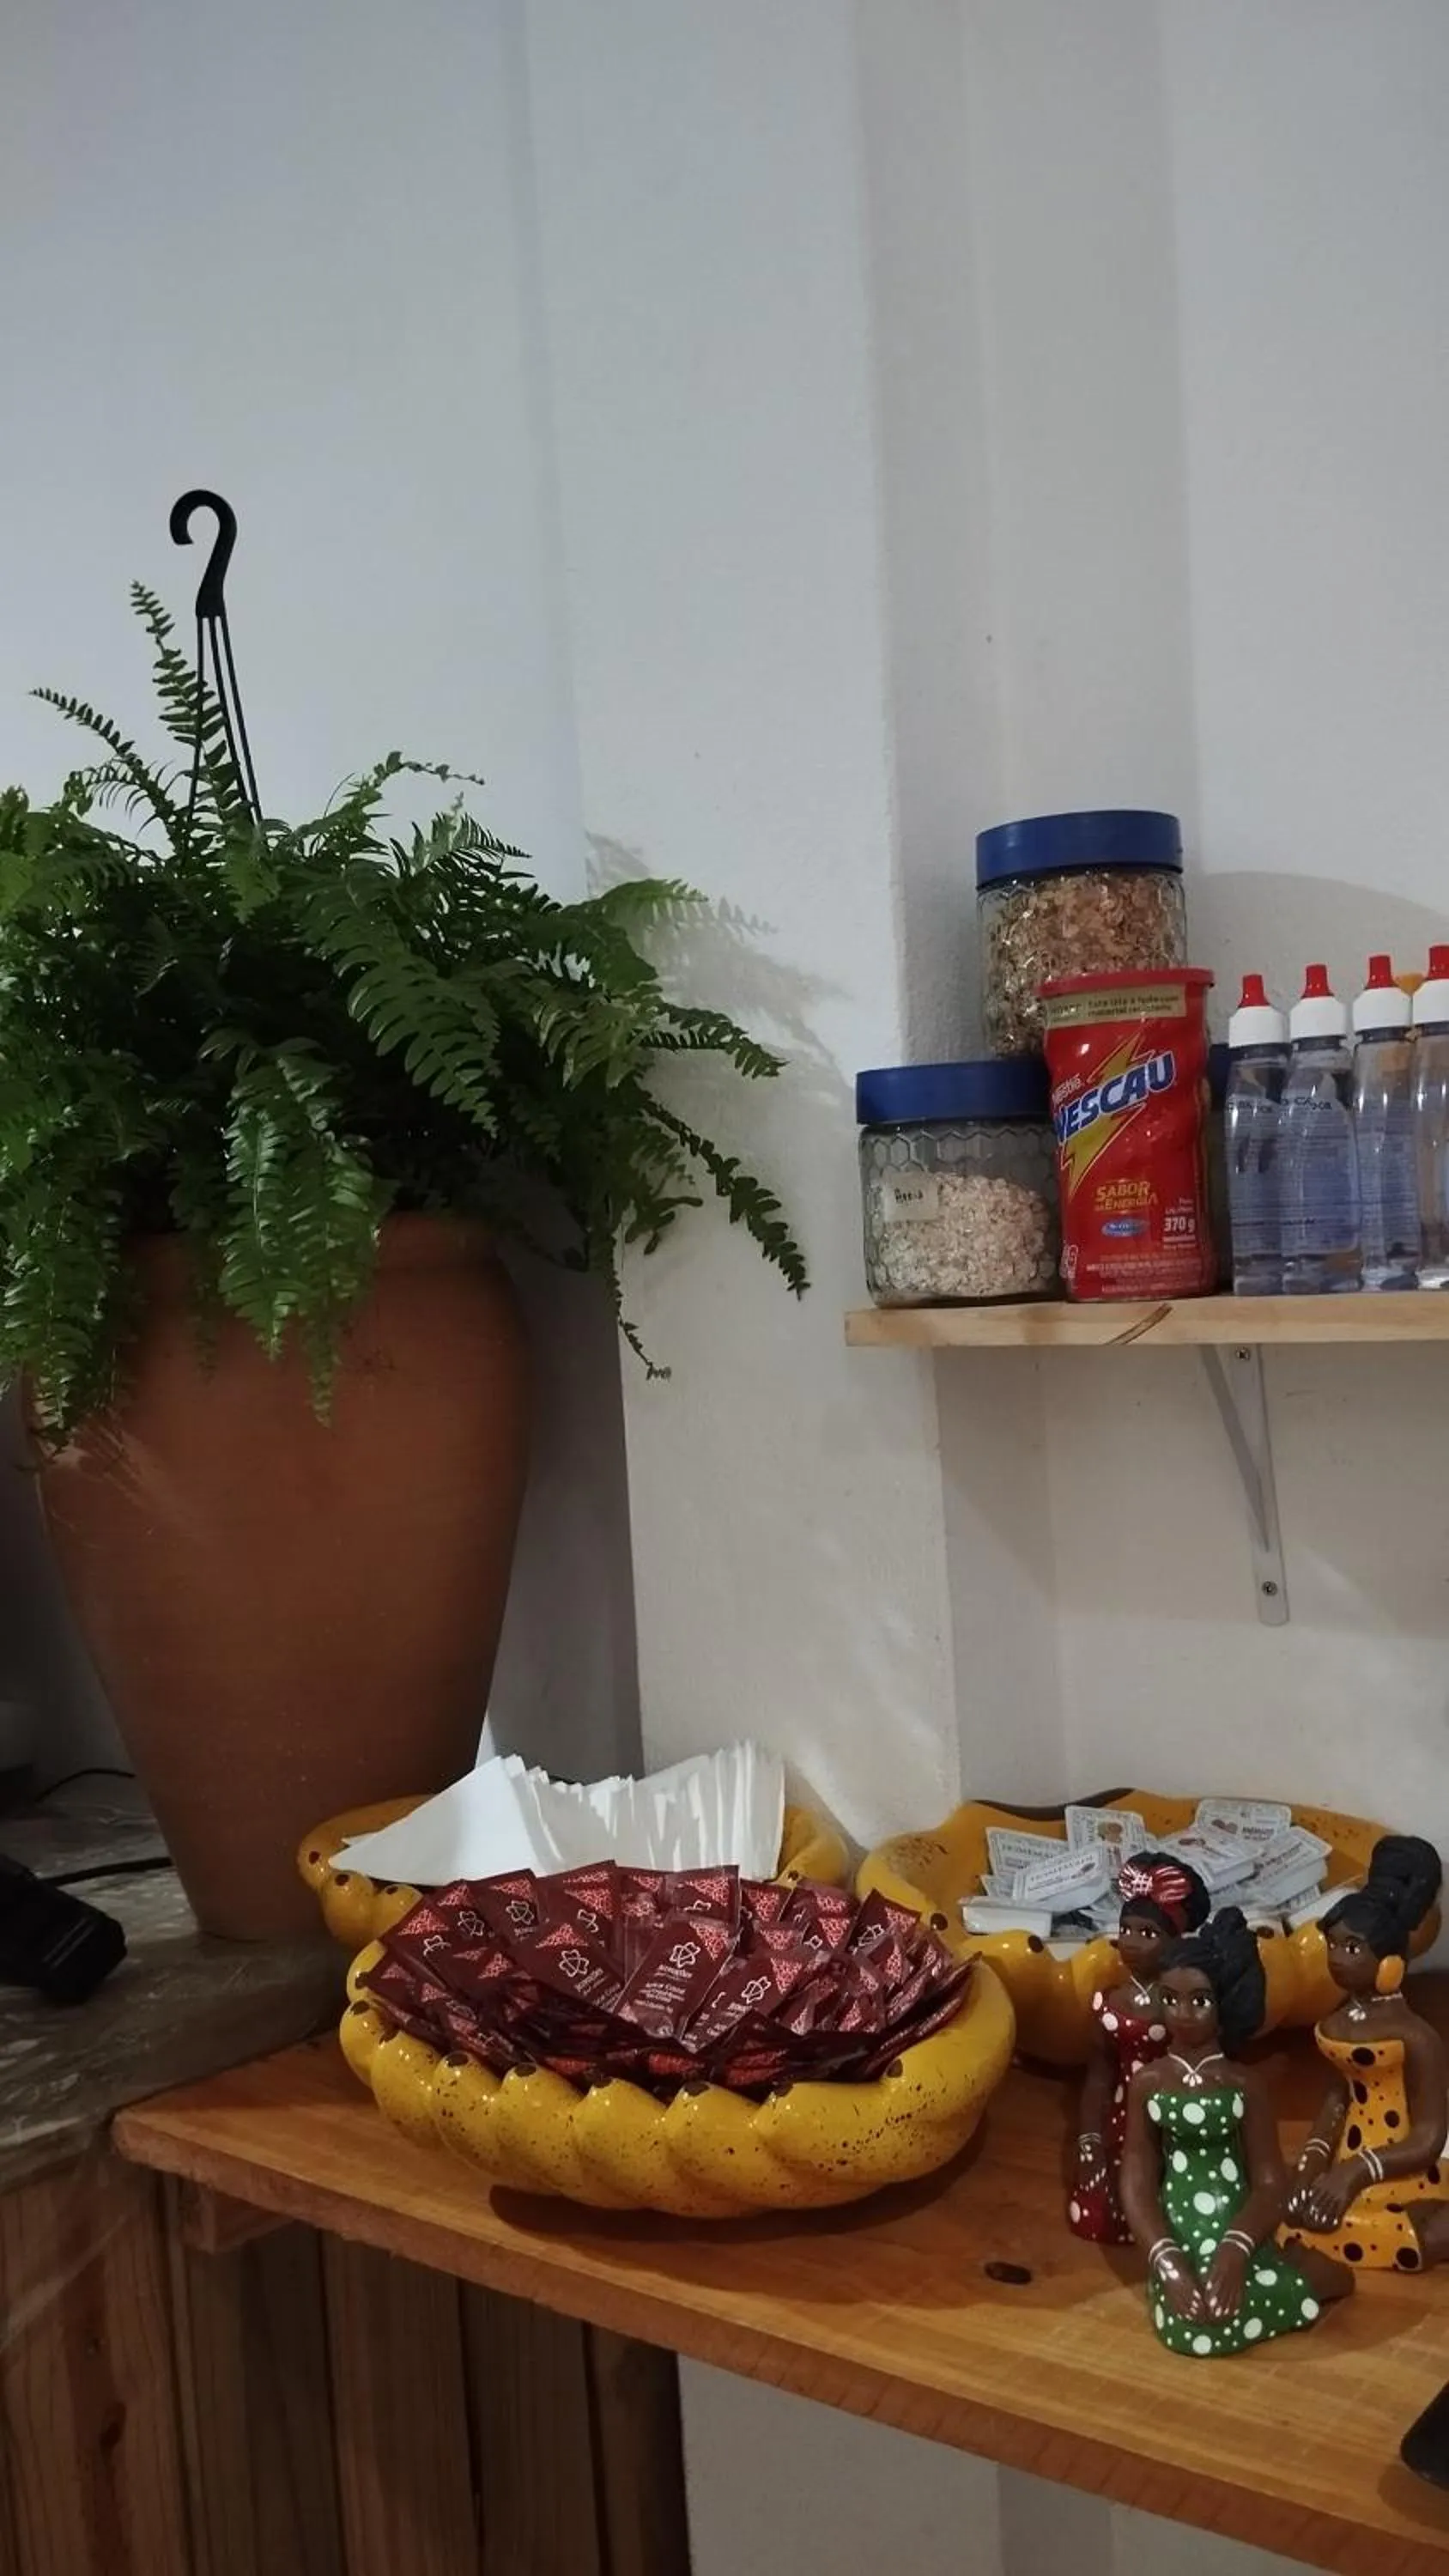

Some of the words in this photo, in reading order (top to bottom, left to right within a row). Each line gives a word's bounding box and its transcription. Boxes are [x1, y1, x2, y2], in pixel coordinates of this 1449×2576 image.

[1055, 1051, 1176, 1145] NESCAU
[1094, 1180, 1151, 1202] SABOR
[1163, 1216, 1186, 1233] 370
[1187, 1218, 1196, 1233] g
